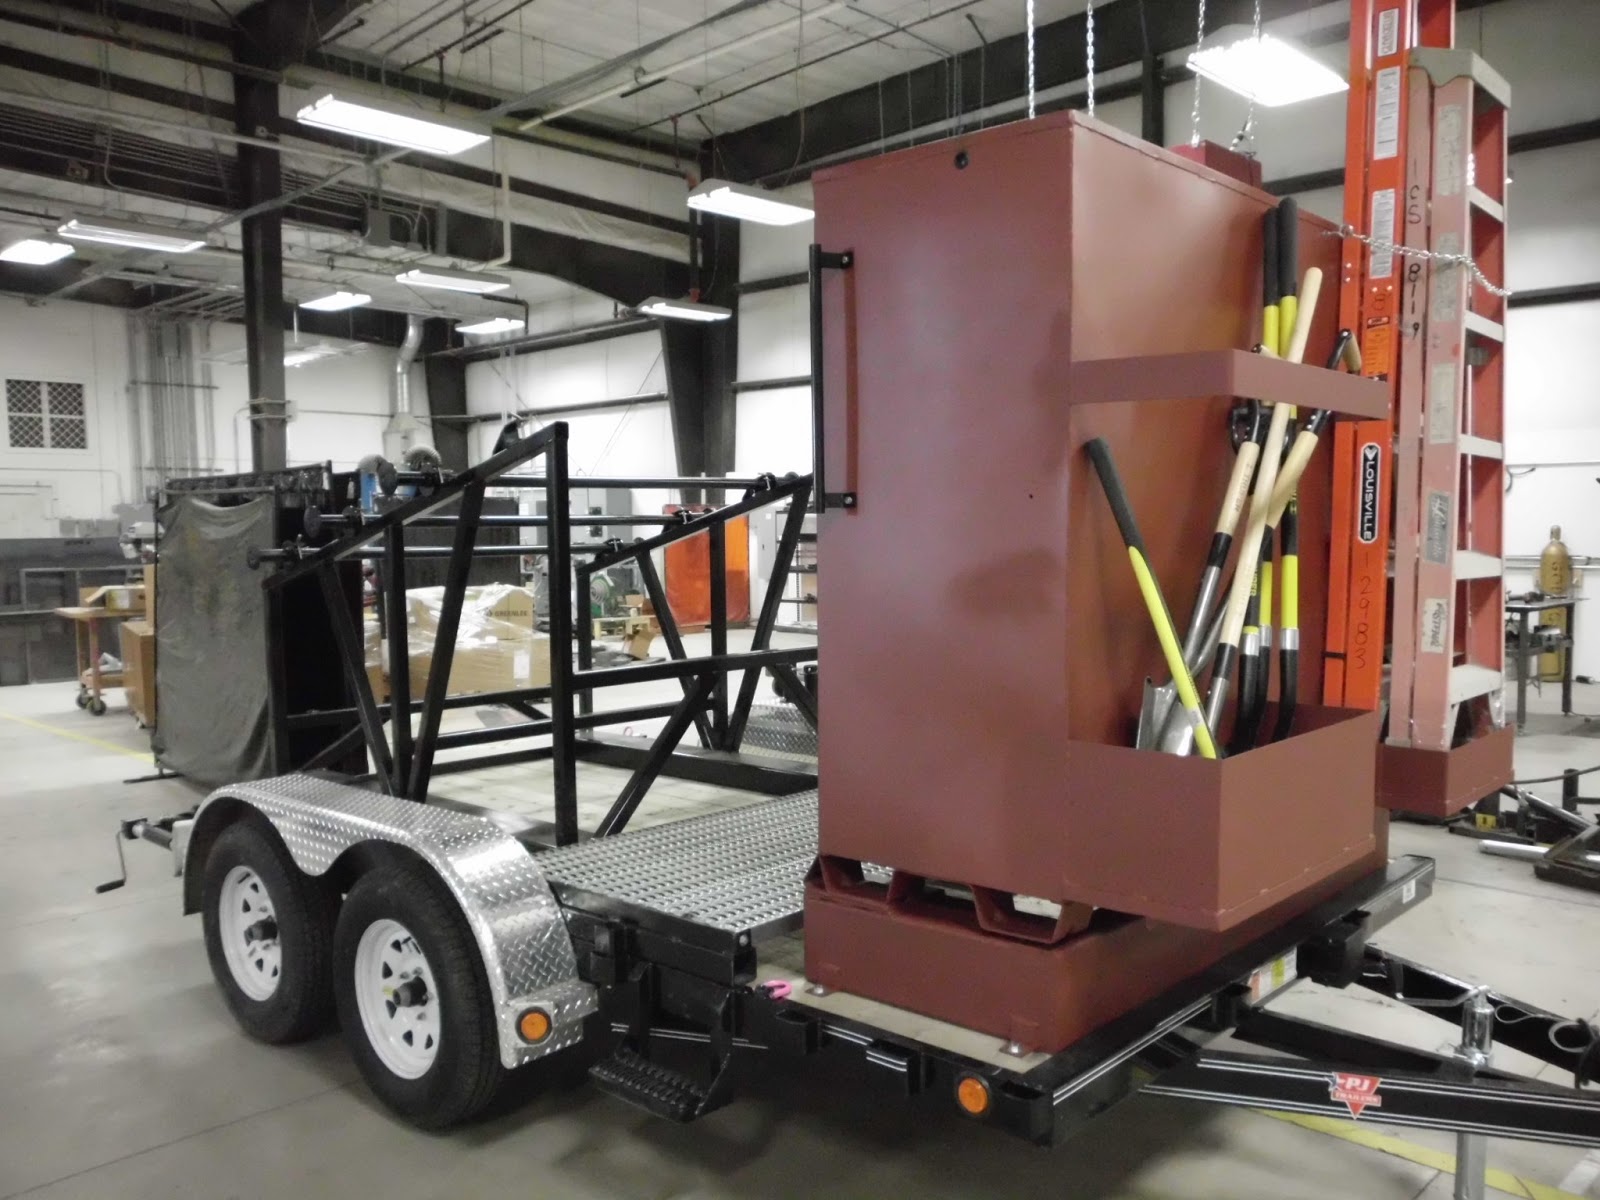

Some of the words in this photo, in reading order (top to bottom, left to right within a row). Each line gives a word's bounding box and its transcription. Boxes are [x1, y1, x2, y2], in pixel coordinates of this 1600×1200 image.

[1364, 461, 1376, 540] LOUISVILLE
[494, 609, 528, 617] GREENLEE
[1345, 1077, 1370, 1091] PJ
